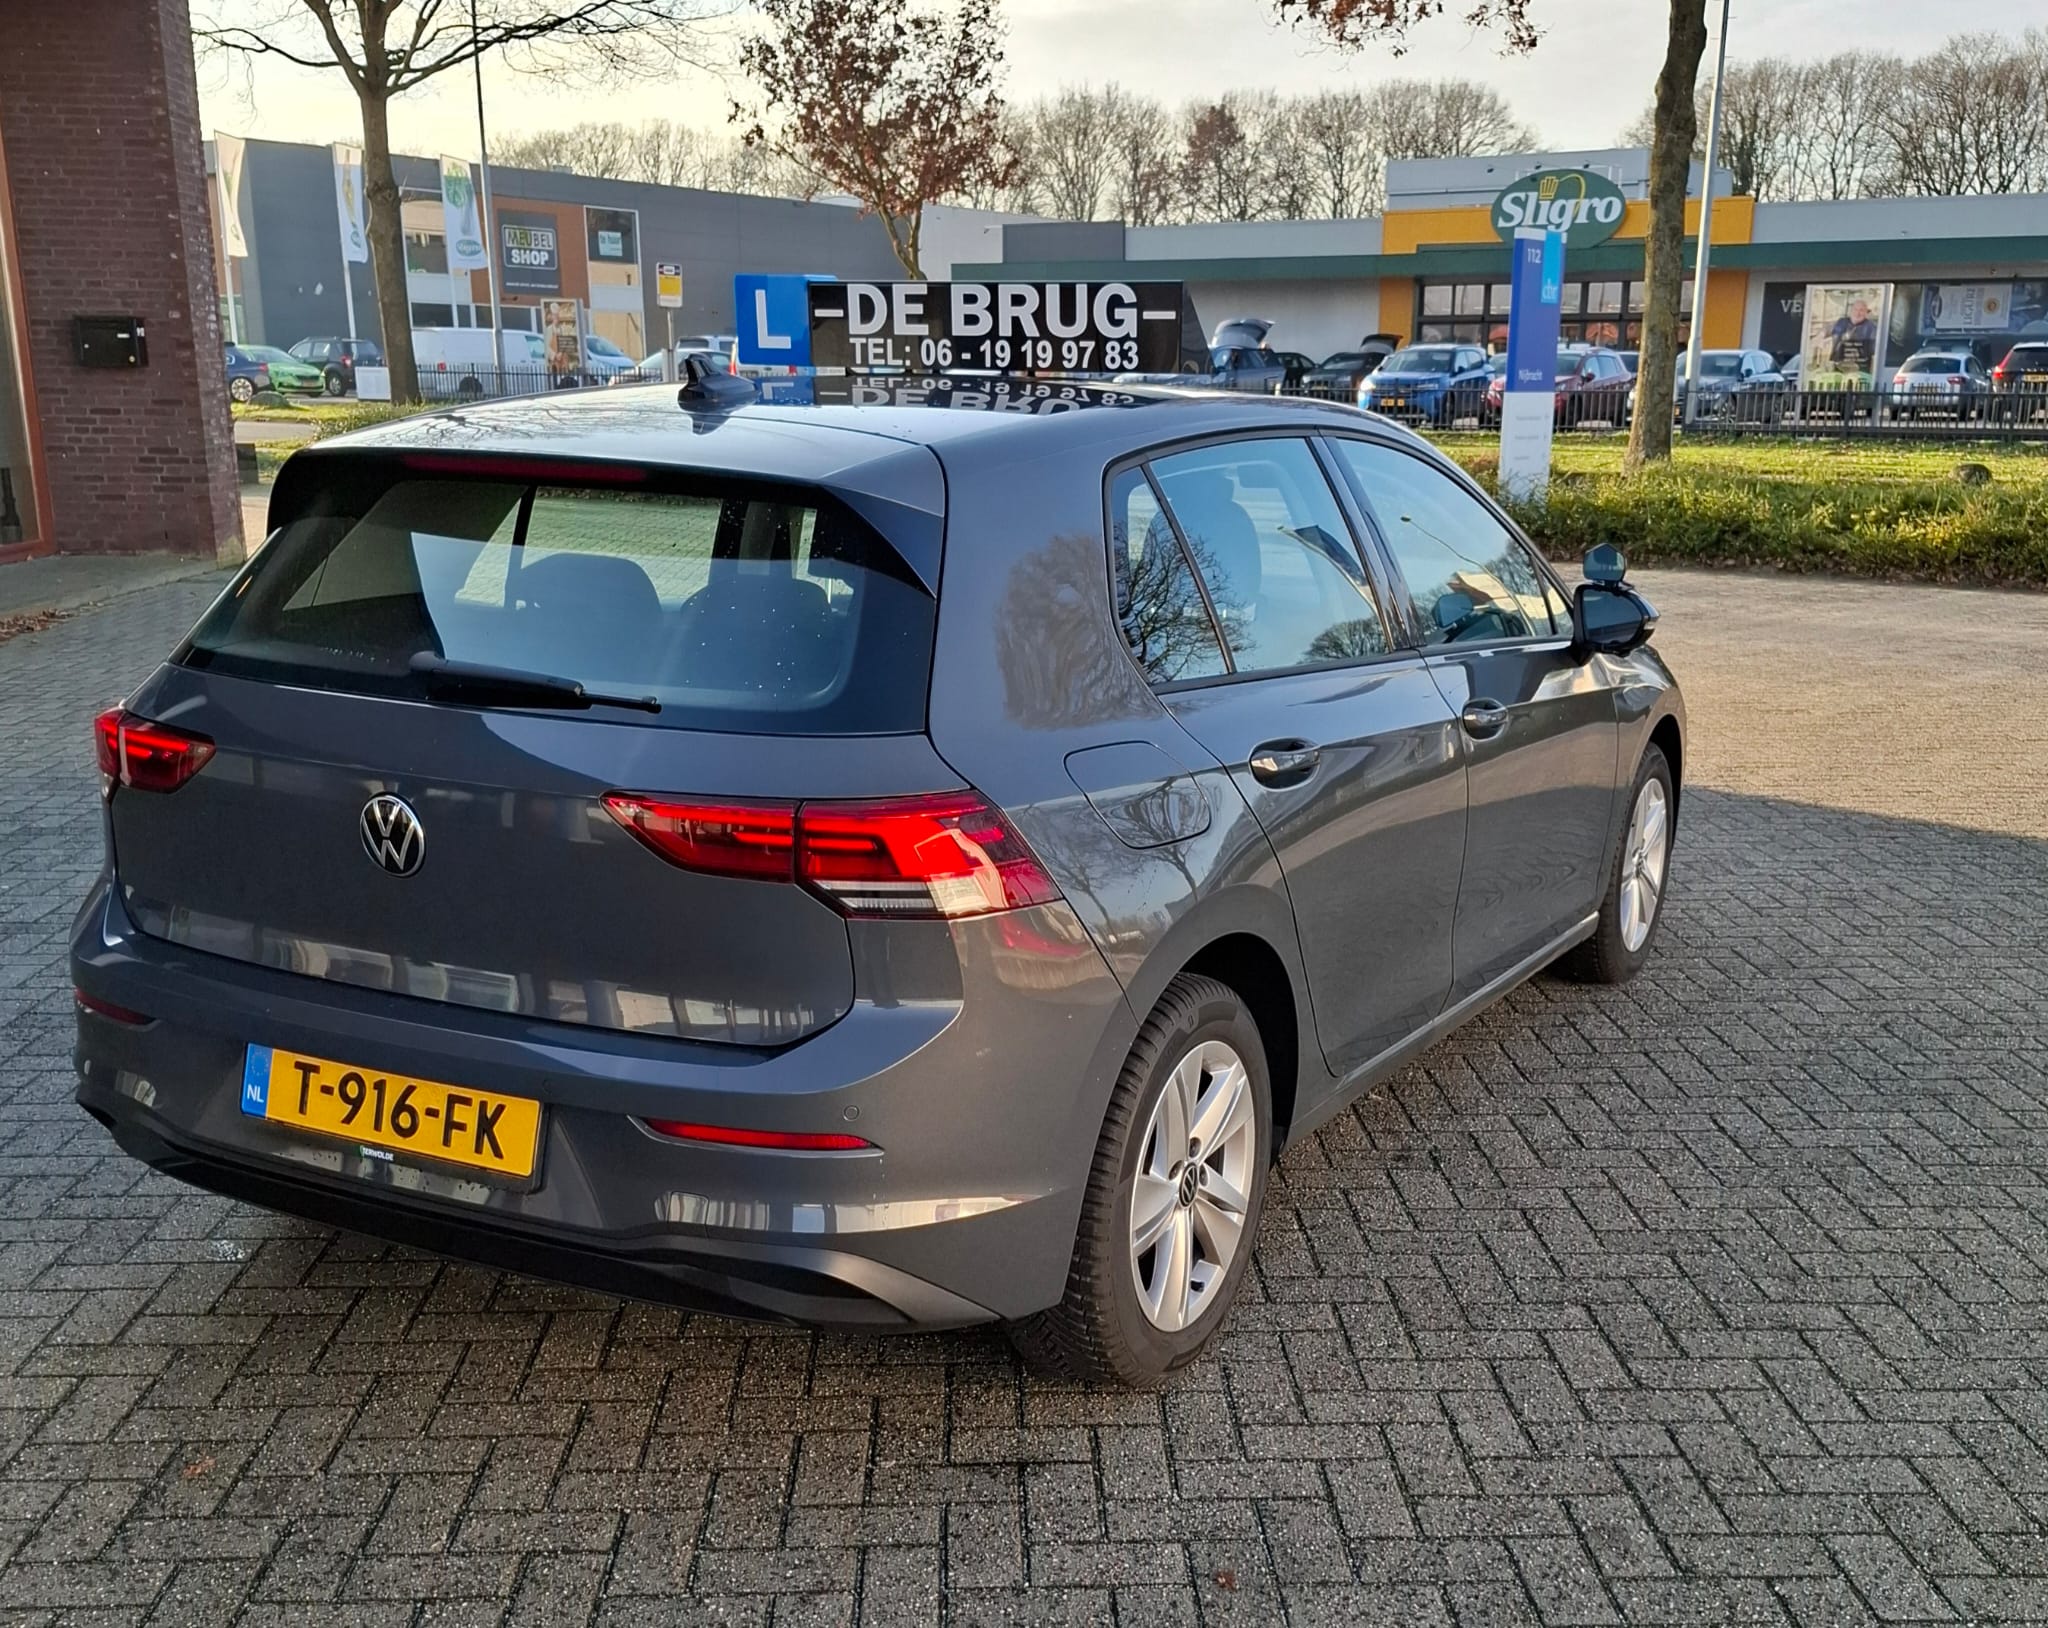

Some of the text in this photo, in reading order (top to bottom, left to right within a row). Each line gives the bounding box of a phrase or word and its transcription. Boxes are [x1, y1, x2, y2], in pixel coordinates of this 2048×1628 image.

[1497, 191, 1622, 232] Sligro
[505, 229, 553, 249] MEUBEL
[511, 249, 549, 266] SHOP
[1527, 248, 1542, 263] 112
[1780, 299, 1804, 313] VE
[755, 289, 791, 349] L
[849, 338, 911, 366] TEL:
[920, 338, 953, 366] 06
[979, 340, 1011, 368] 19
[1021, 340, 1053, 368] 19
[1062, 341, 1096, 369] 97
[1105, 341, 1139, 370] 83
[246, 1084, 264, 1103] NL
[294, 1060, 506, 1160] T-916-FK
